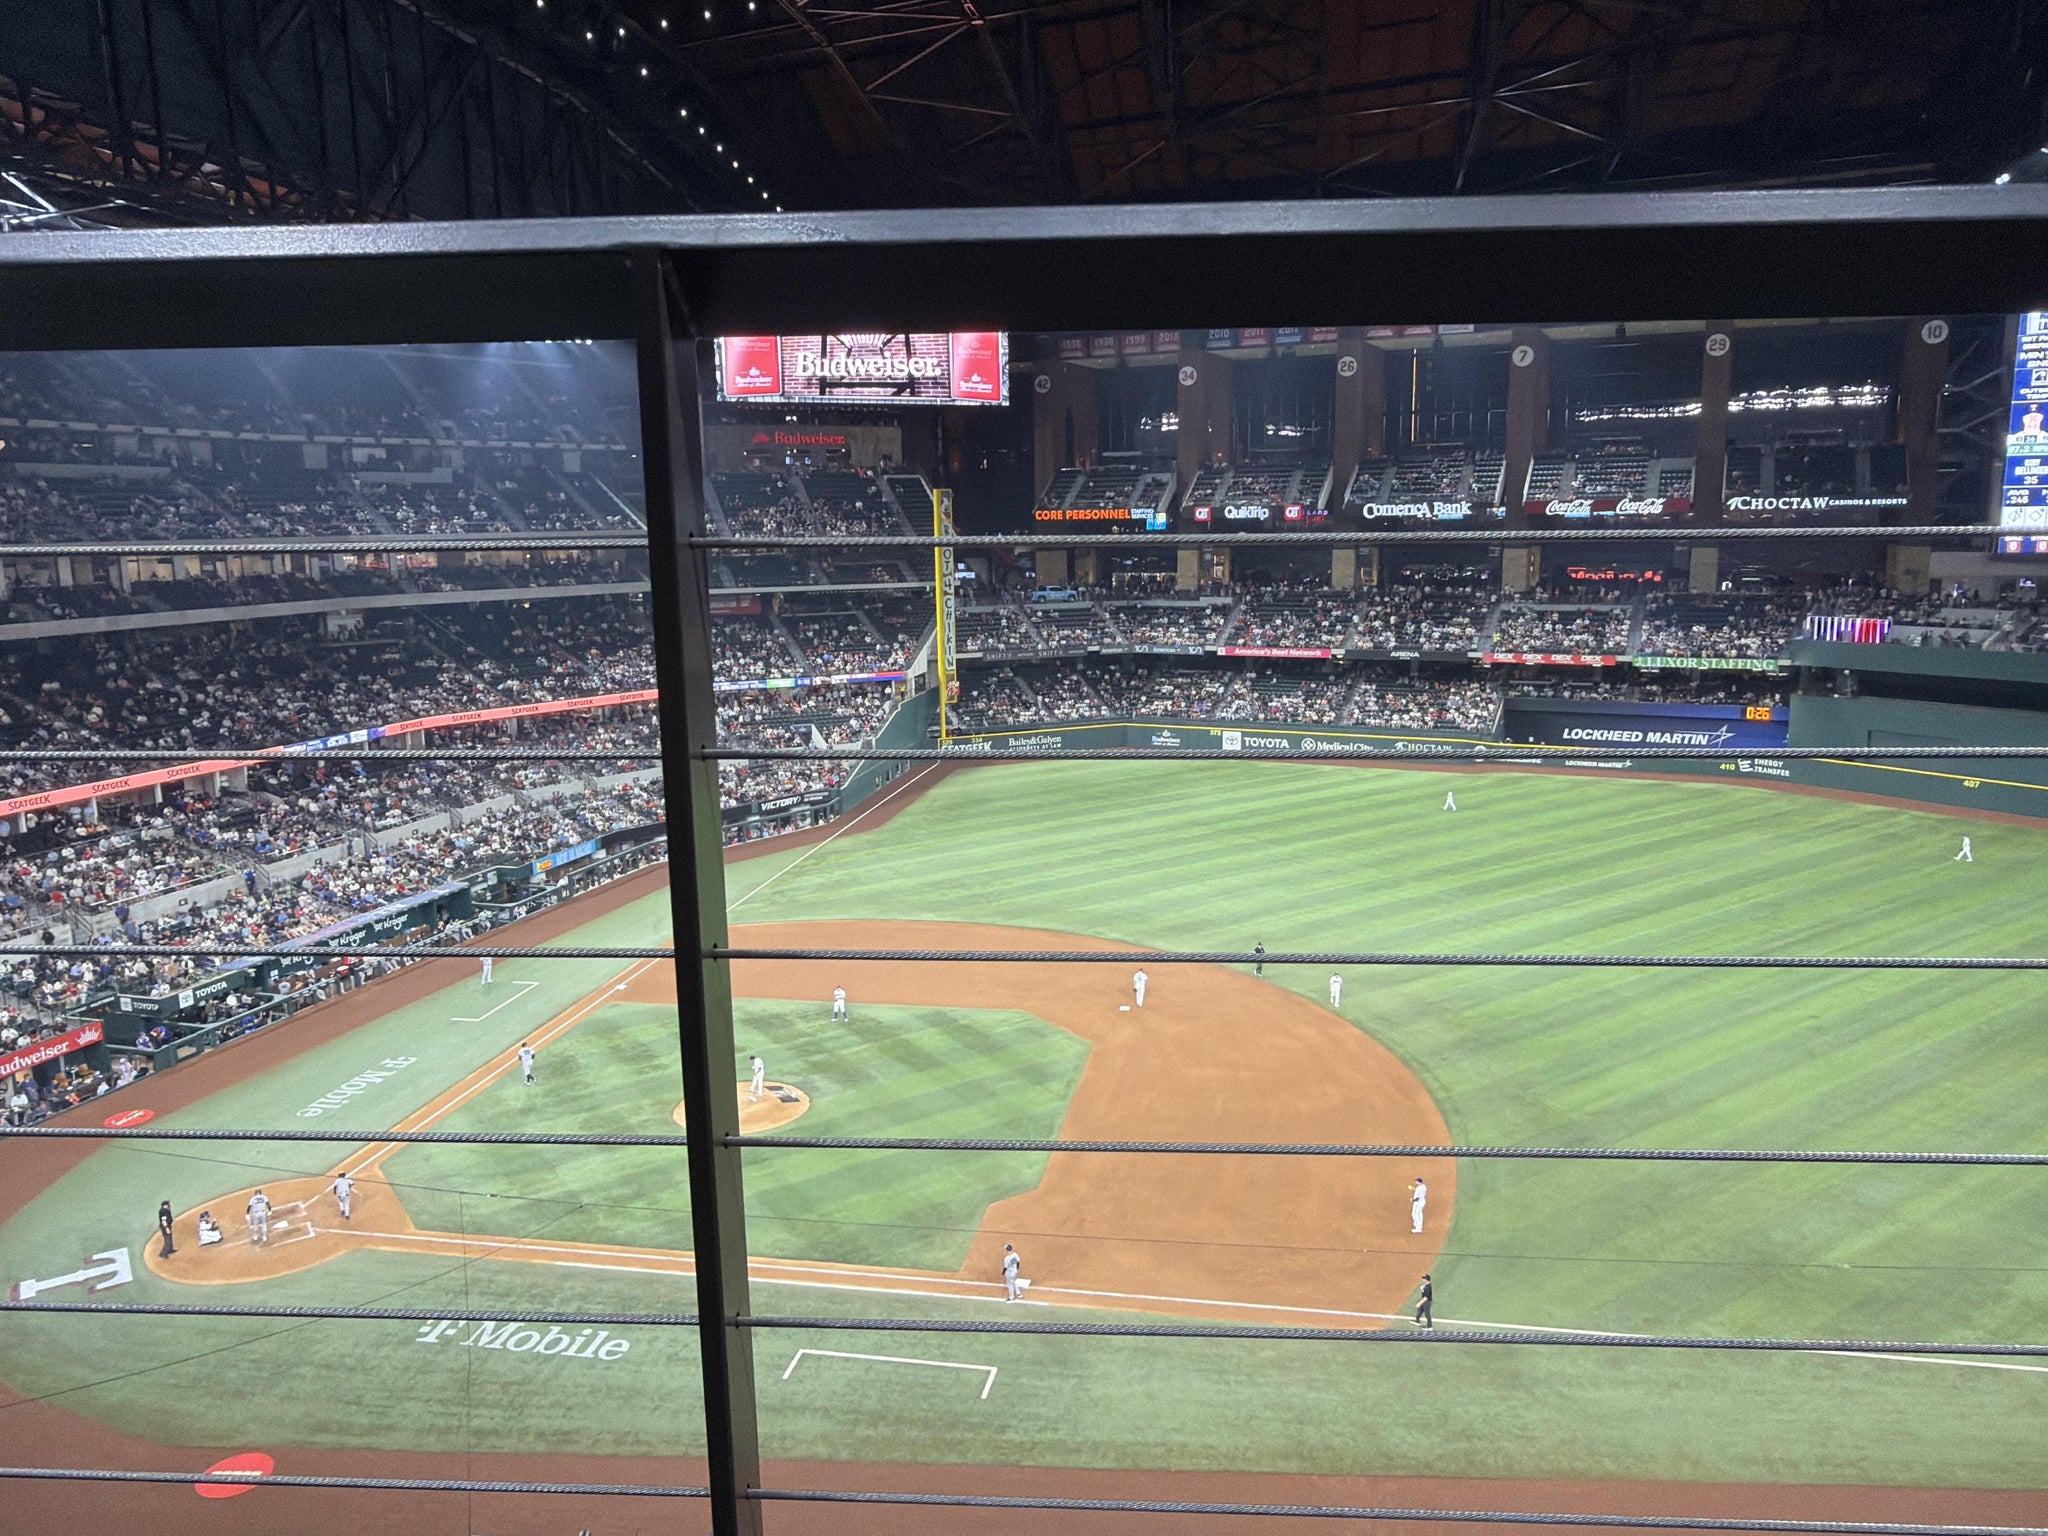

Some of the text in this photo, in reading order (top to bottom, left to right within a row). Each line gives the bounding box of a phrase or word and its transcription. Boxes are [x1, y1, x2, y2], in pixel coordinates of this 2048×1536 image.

[1927, 326, 1942, 338] 10
[1710, 340, 1726, 352] 29
[1519, 351, 1527, 362] 7
[1341, 361, 1354, 372] 26
[1182, 370, 1194, 382] 34
[1037, 378, 1049, 390] 42
[1433, 501, 1472, 516] Bank
[1738, 496, 1829, 510] CHOCTAW
[1035, 508, 1130, 521] CORE PERSONNEL
[1224, 506, 1269, 520] QuikTrip
[1700, 658, 1774, 670] STAFFING
[1746, 706, 1770, 720] 0:26
[1244, 736, 1290, 749] TOYOTA
[1563, 728, 1709, 746] LOCKHEED MARTIN
[1317, 741, 1353, 751] Medical
[1565, 760, 1622, 769] LOCKHEED MARTIN
[1754, 758, 1784, 768] ENERGY
[166, 764, 202, 778] SEATGEEK
[1754, 767, 1790, 777] TRANSFER
[91, 779, 130, 794] SEATGEEK
[1963, 779, 1980, 788] 407
[8, 794, 51, 811] SEATGEEK
[384, 914, 408, 930] Kroger
[340, 930, 366, 947] Kroger
[195, 981, 228, 998] TOYOTA
[132, 1002, 160, 1011] TOYOTA
[0, 1042, 70, 1076] udweiser
